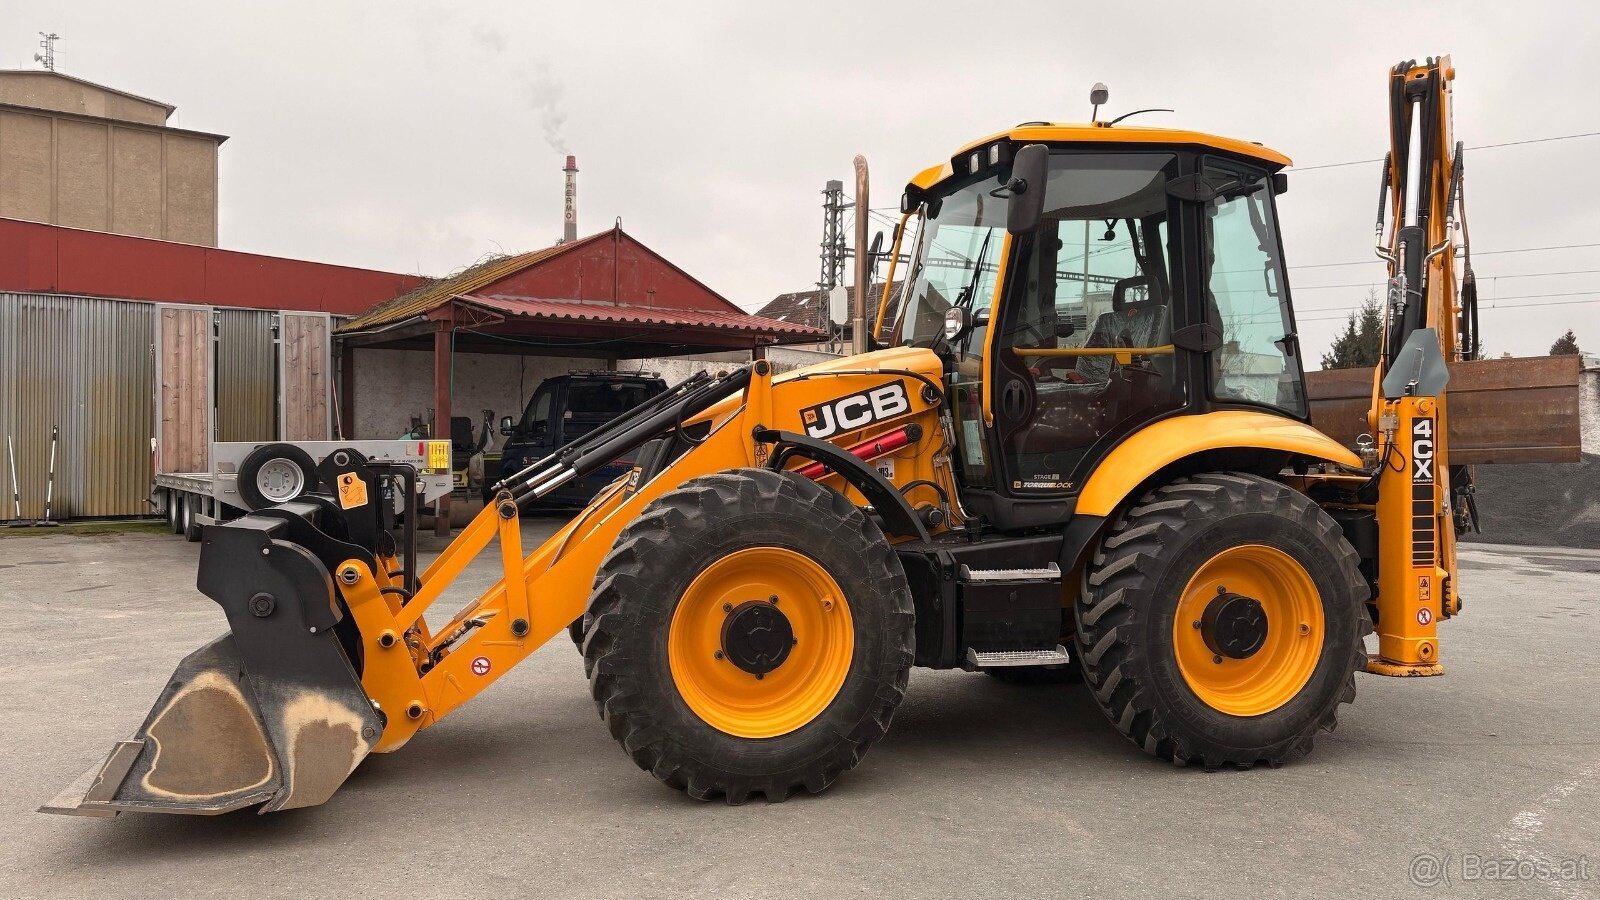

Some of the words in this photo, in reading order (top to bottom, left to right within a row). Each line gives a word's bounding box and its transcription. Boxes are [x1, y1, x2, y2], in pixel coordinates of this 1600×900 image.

[565, 175, 573, 219] THERMO
[807, 384, 908, 439] JCB
[1413, 419, 1433, 478] 4CX
[1023, 481, 1073, 489] TORQUELOCK
